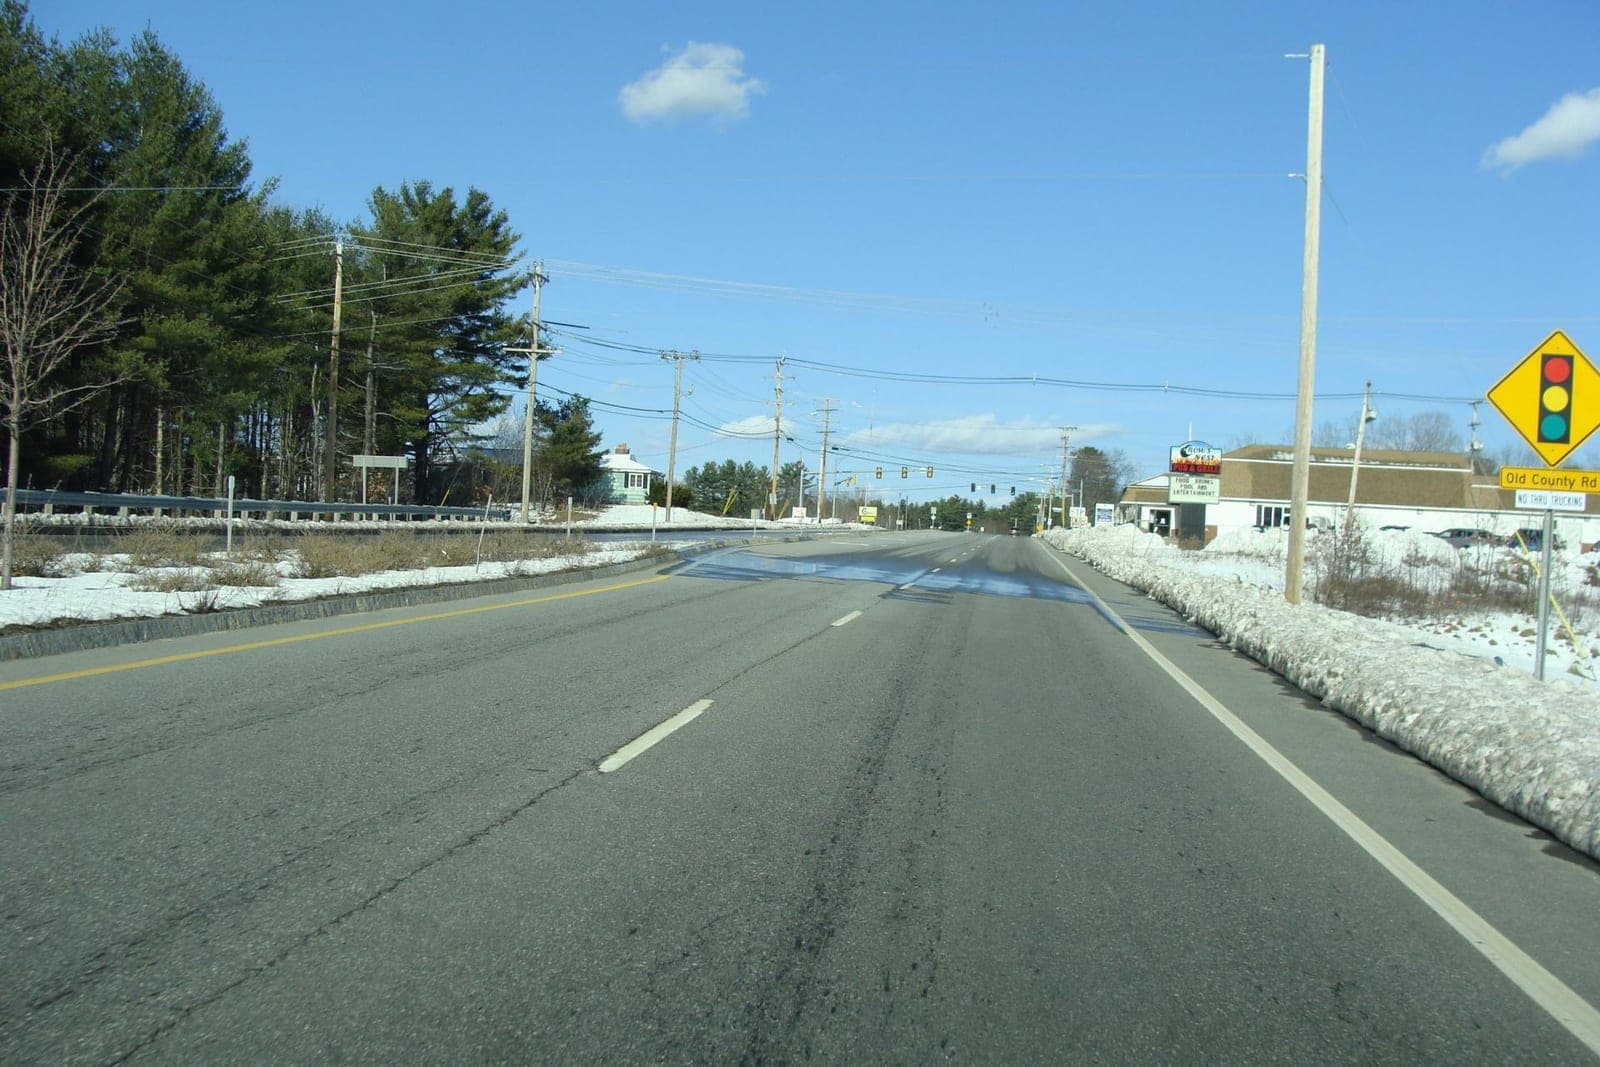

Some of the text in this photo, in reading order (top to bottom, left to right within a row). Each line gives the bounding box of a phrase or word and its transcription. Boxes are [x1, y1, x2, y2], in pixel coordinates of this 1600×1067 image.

[1506, 472, 1597, 489] Old County Rd
[1518, 493, 1584, 507] NO THRU TRUCKING
